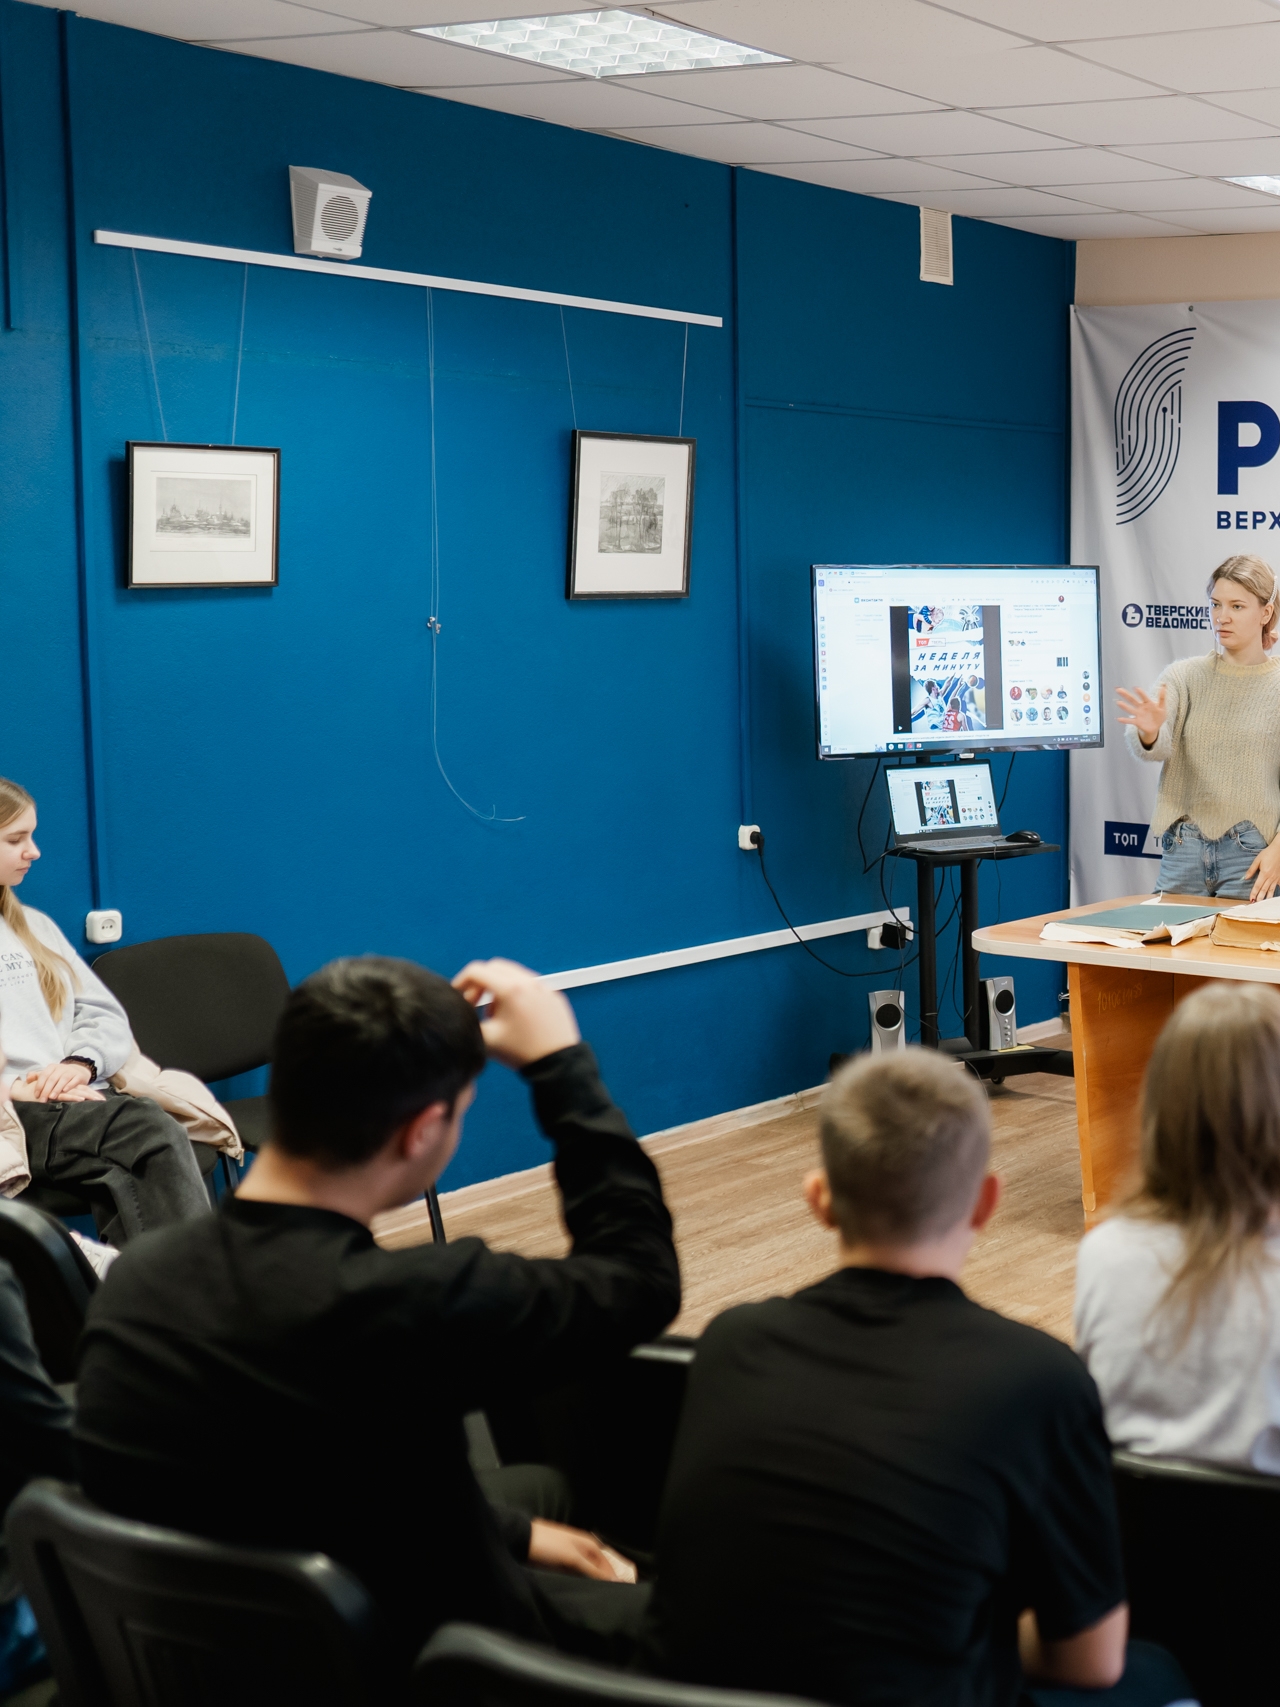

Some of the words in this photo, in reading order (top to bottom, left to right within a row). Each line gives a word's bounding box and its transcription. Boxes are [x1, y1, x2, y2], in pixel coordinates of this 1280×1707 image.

[918, 652, 980, 662] НЕДЕЛЯ
[914, 664, 926, 672] ЗА
[933, 663, 980, 671] МИНУТУ
[1113, 832, 1138, 847] ТОП
